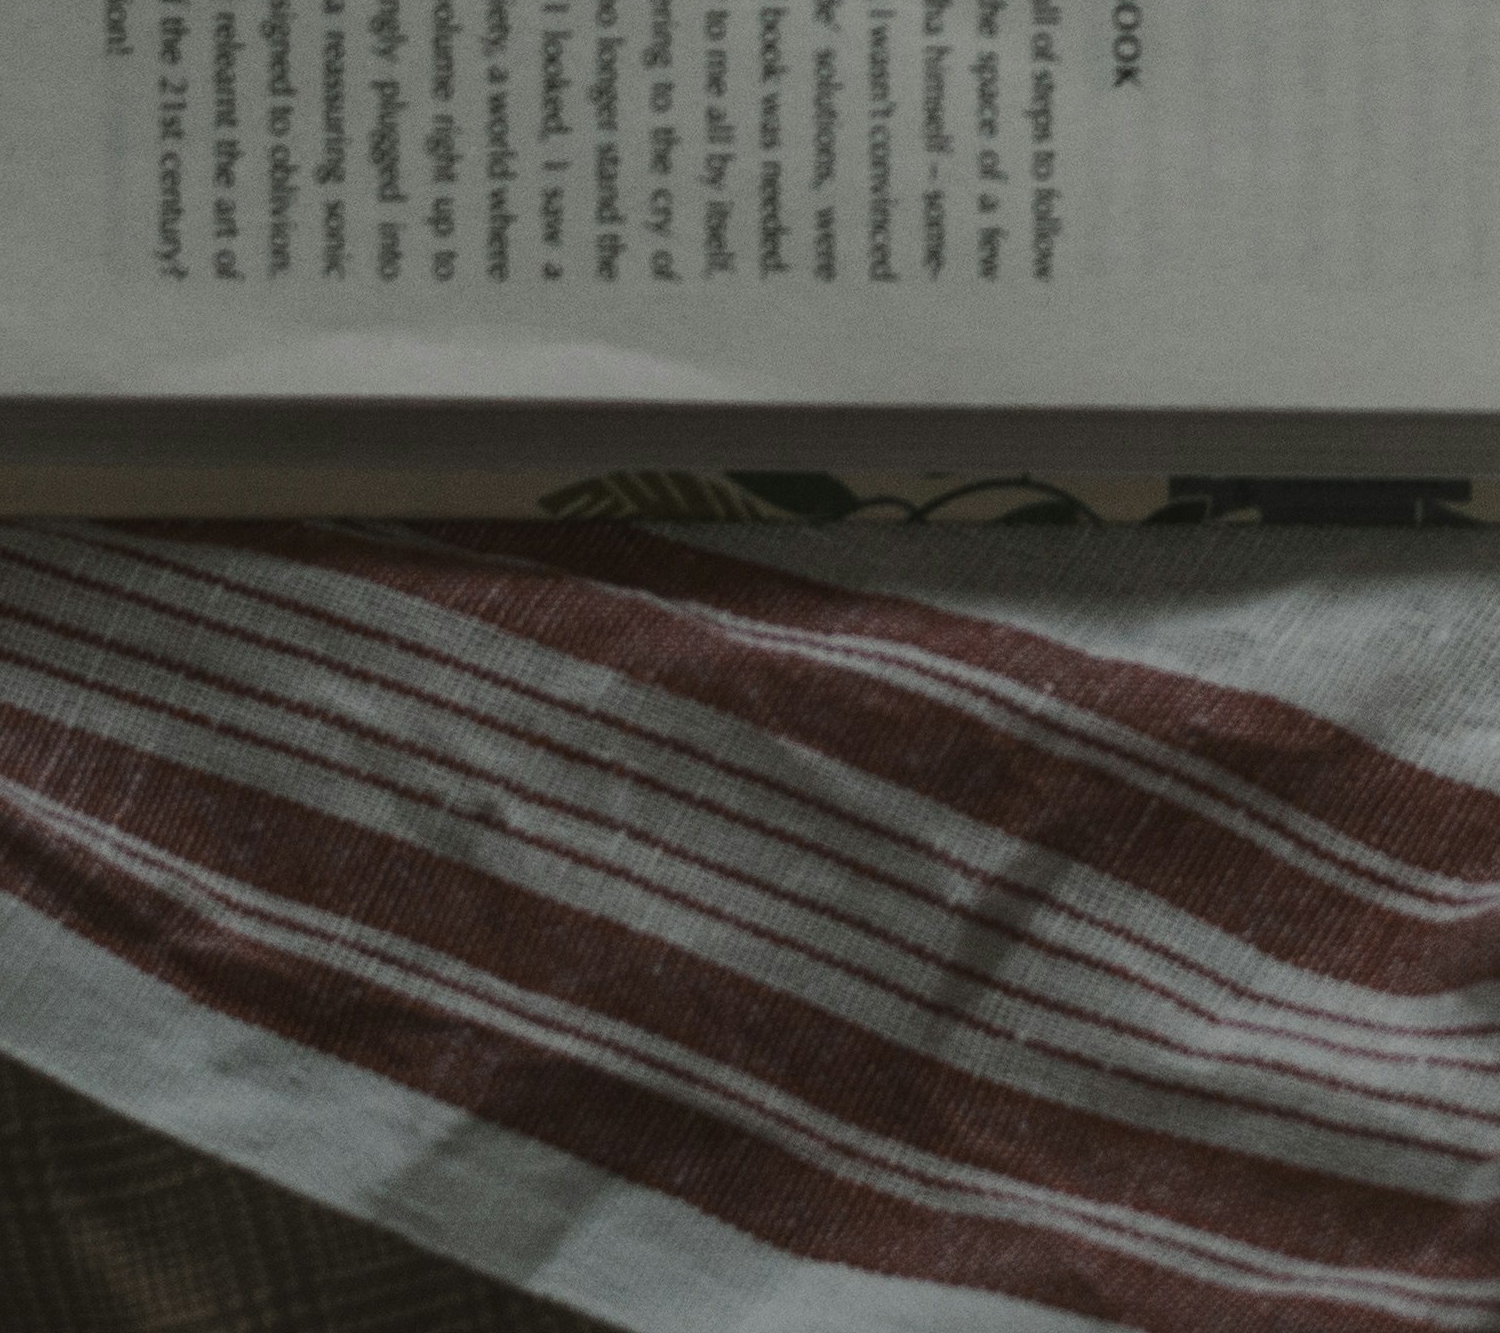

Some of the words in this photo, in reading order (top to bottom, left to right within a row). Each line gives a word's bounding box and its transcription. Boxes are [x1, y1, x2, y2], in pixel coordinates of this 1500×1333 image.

[159, 14, 190, 68] the
[212, 12, 245, 127] relearnt
[705, 49, 728, 97] me
[759, 7, 788, 82] book
[158, 74, 188, 144] 21st
[313, 30, 348, 185] reassuring
[538, 31, 572, 140] looked,
[587, 37, 625, 132] longer
[759, 93, 782, 150] was
[811, 49, 844, 193] solutions,
[923, 45, 953, 154] himself
[970, 51, 999, 138] space
[1024, 69, 1056, 144] steps
[212, 140, 244, 187] the
[368, 79, 408, 203] plugged
[424, 114, 463, 183] right
[485, 91, 517, 181] world
[650, 126, 681, 176] the
[154, 149, 189, 284] century?
[213, 199, 239, 237] art
[267, 144, 299, 277] oblivion.
[425, 197, 455, 238] up
[540, 188, 564, 245] saw
[595, 142, 626, 225] stand
[644, 187, 673, 236] cry
[758, 161, 790, 280] needed.
[868, 124, 899, 283] convinced
[322, 199, 350, 276] sonic
[376, 222, 405, 282] into
[486, 186, 517, 283] where
[595, 232, 627, 282] the
[704, 201, 736, 279] itself,
[813, 207, 837, 282] were
[922, 189, 946, 281] some-
[978, 226, 1007, 281] few
[1032, 188, 1062, 280] follow
